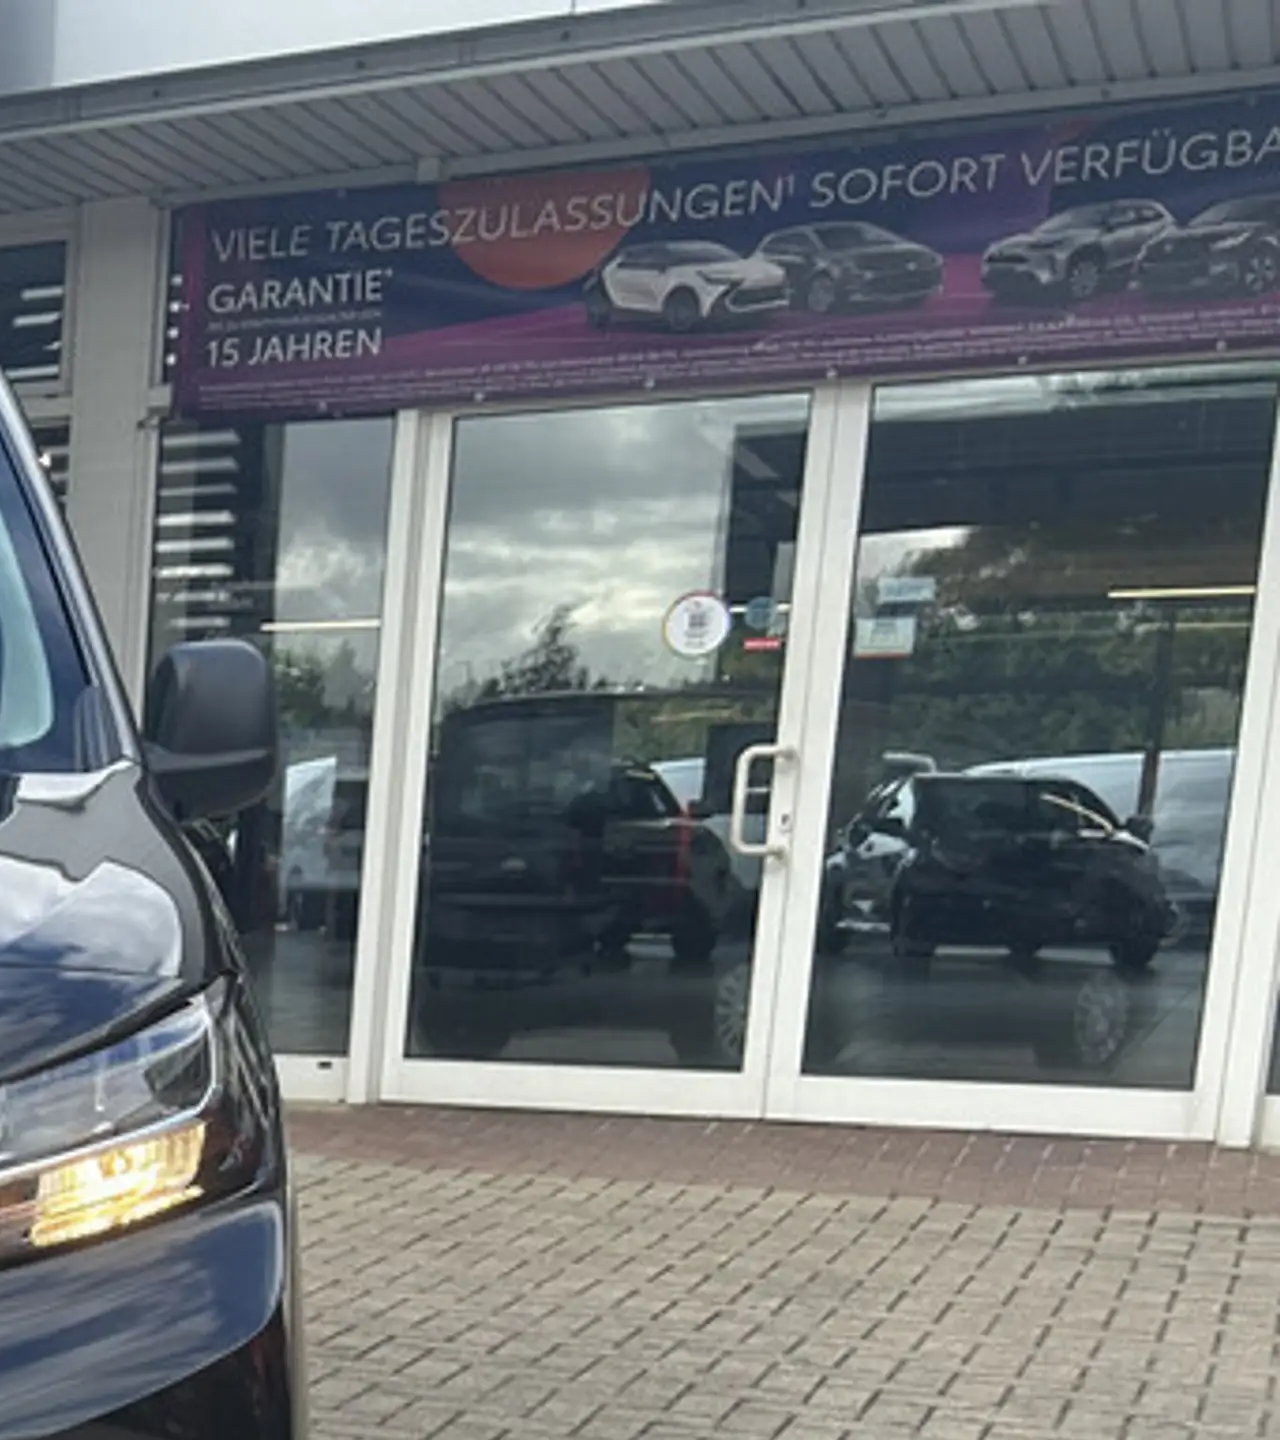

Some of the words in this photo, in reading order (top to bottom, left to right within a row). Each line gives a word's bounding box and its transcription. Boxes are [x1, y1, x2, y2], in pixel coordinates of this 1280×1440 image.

[210, 223, 311, 263] VIELE
[808, 153, 1005, 208] SOFORT
[206, 340, 240, 369] 15
[248, 327, 383, 366] JAHREN
